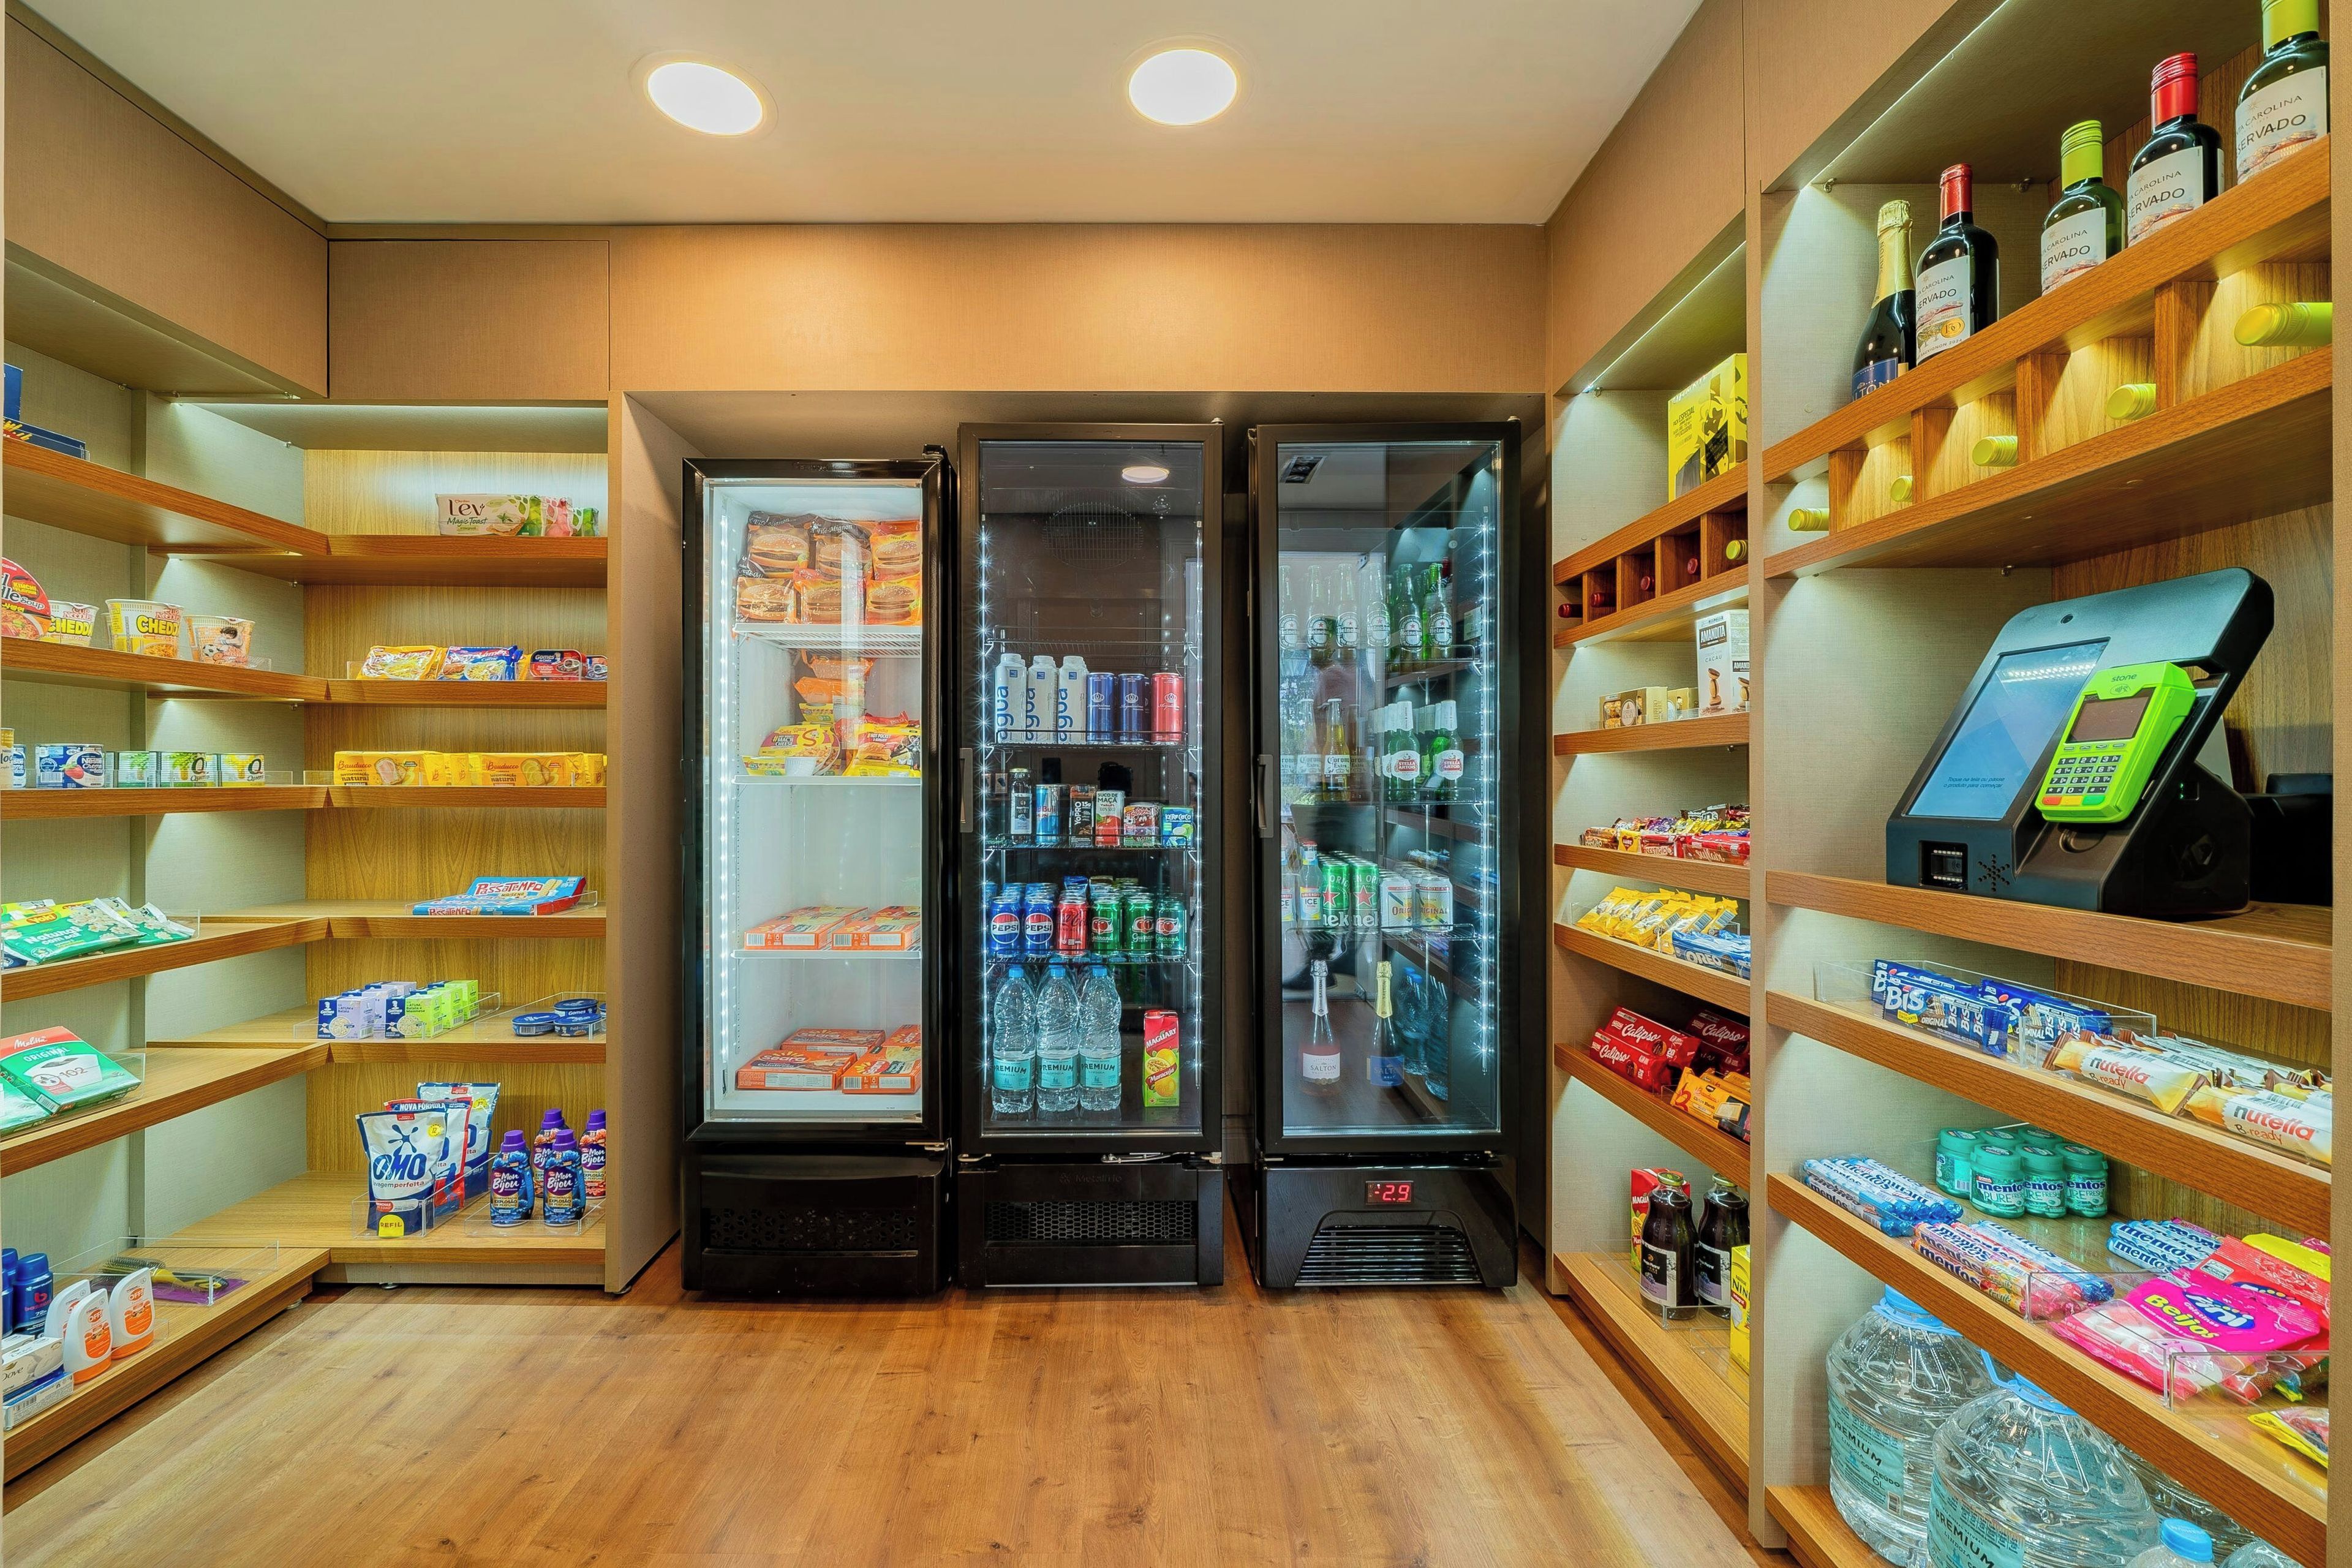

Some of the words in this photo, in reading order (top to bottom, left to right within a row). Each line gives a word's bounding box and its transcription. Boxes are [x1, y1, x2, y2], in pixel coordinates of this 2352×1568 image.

[2245, 95, 2303, 128] CAROLINA
[2133, 170, 2182, 198] CAROLINA
[2046, 228, 2088, 252] CAROLINA
[1921, 275, 1955, 292] CAROLINA
[449, 499, 485, 516] Lev
[1700, 625, 1725, 643] AMANDITA
[2111, 673, 2138, 683] stone
[337, 760, 372, 770] Bauducco
[487, 761, 519, 771] Bauducco
[1686, 950, 1722, 966] OREO
[1921, 1017, 1948, 1028] ORIGINAL
[1622, 1023, 1661, 1043] Calipso
[1702, 1023, 1745, 1042] Calipso
[13, 1035, 47, 1049] Melitta
[23, 1047, 71, 1063] ORIGINAL
[1599, 1044, 1630, 1065] Calipso
[60, 1067, 88, 1079] 102
[994, 1065, 1027, 1074] PREMIUM
[2089, 1055, 2152, 1085] nutella
[2233, 1104, 2318, 1142] nutella
[372, 1152, 427, 1181] OMO
[581, 1154, 606, 1167] Bijou
[492, 1178, 520, 1193] Bijou
[547, 1178, 573, 1192] Bijou
[2022, 1182, 2064, 1191] entos
[2067, 1182, 2106, 1191] entos
[1985, 1191, 2013, 1203] PURE
[2119, 1224, 2198, 1262] mentos
[1919, 1244, 1981, 1287] mentos
[1989, 1288, 2013, 1303] fruit
[2144, 1294, 2220, 1340] Beijos
[2184, 1302, 2220, 1328] Gelatinas
[1833, 1420, 1882, 1468] PREMIUM
[1861, 1461, 1901, 1488] CONTEÚDO
[1872, 1476, 1885, 1491] 6L
[1936, 1509, 1995, 1568] PREMIUM
